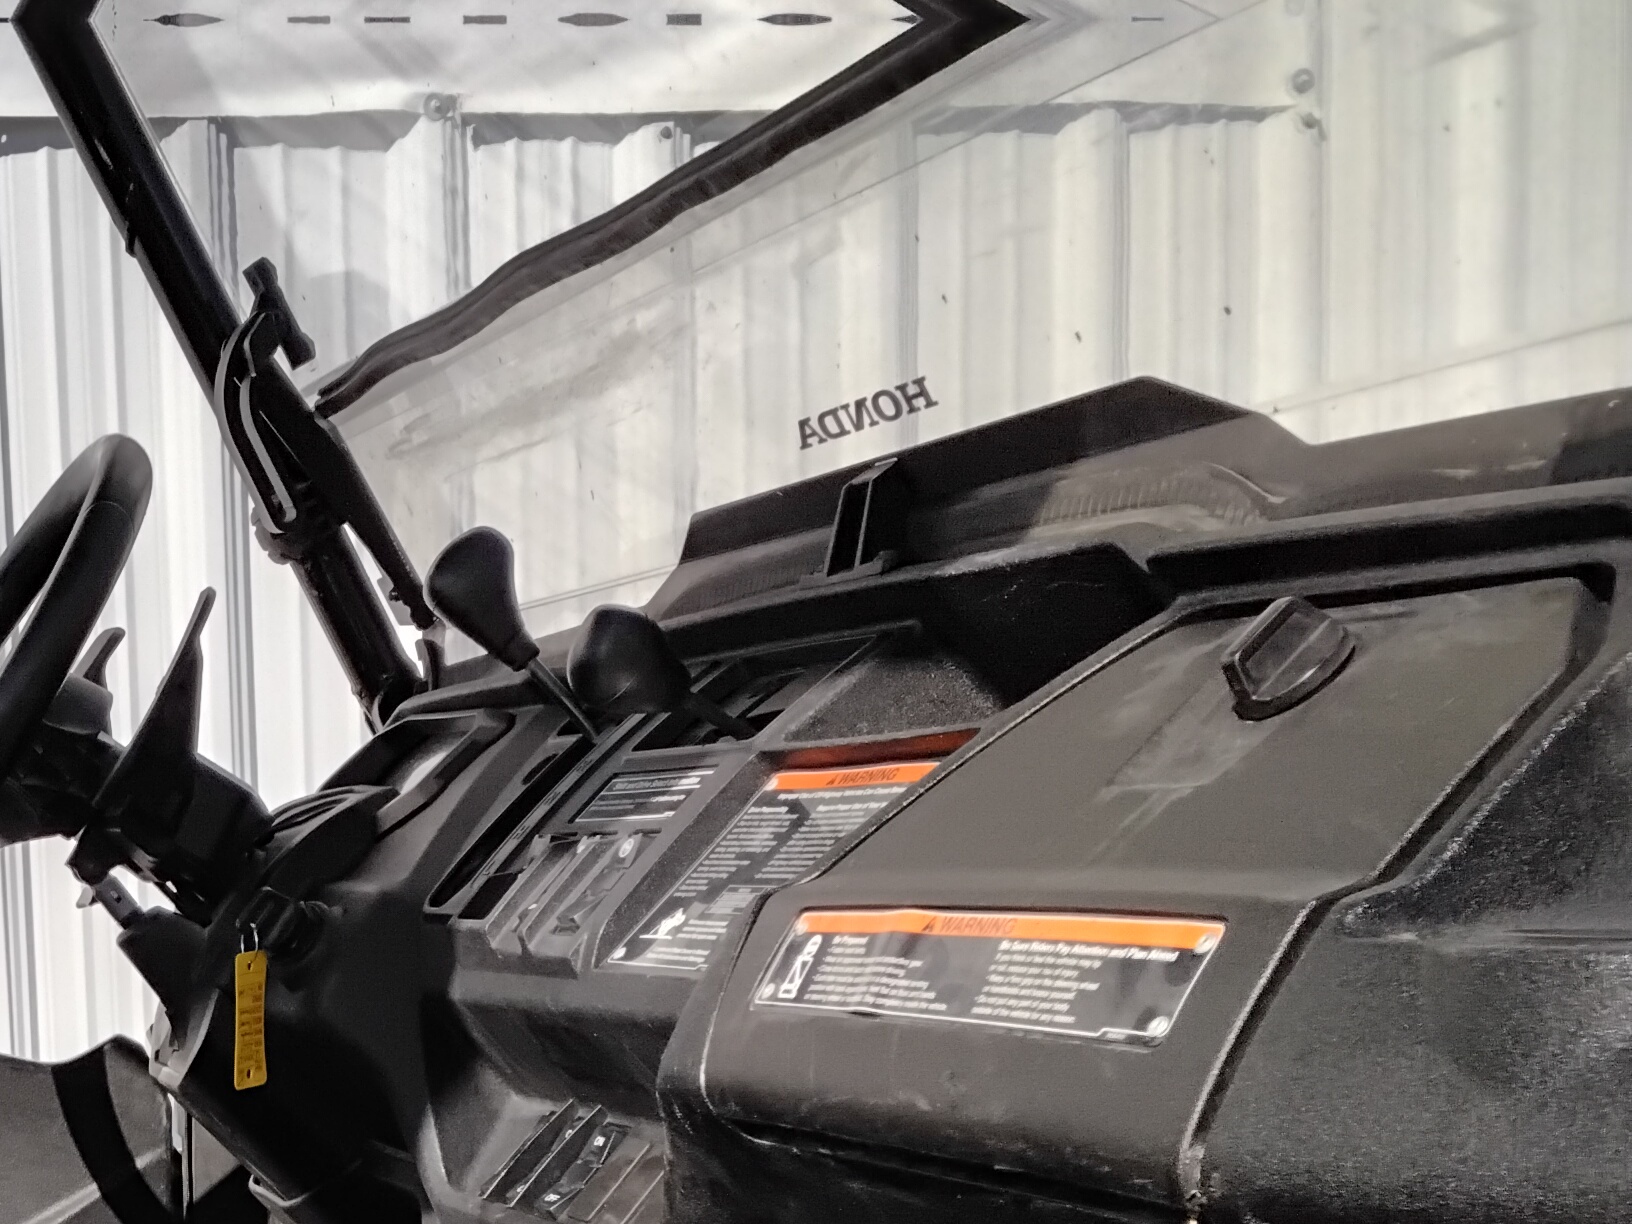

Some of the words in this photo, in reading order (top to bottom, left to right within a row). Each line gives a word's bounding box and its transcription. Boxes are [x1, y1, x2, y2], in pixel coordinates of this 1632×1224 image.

[837, 768, 899, 784] WARNING
[940, 916, 1019, 934] WARNING
[998, 940, 1012, 951] Be
[1010, 940, 1030, 952] Sure
[1028, 941, 1056, 953] Riders
[1054, 942, 1072, 956] Pay
[1069, 943, 1110, 957] Attention
